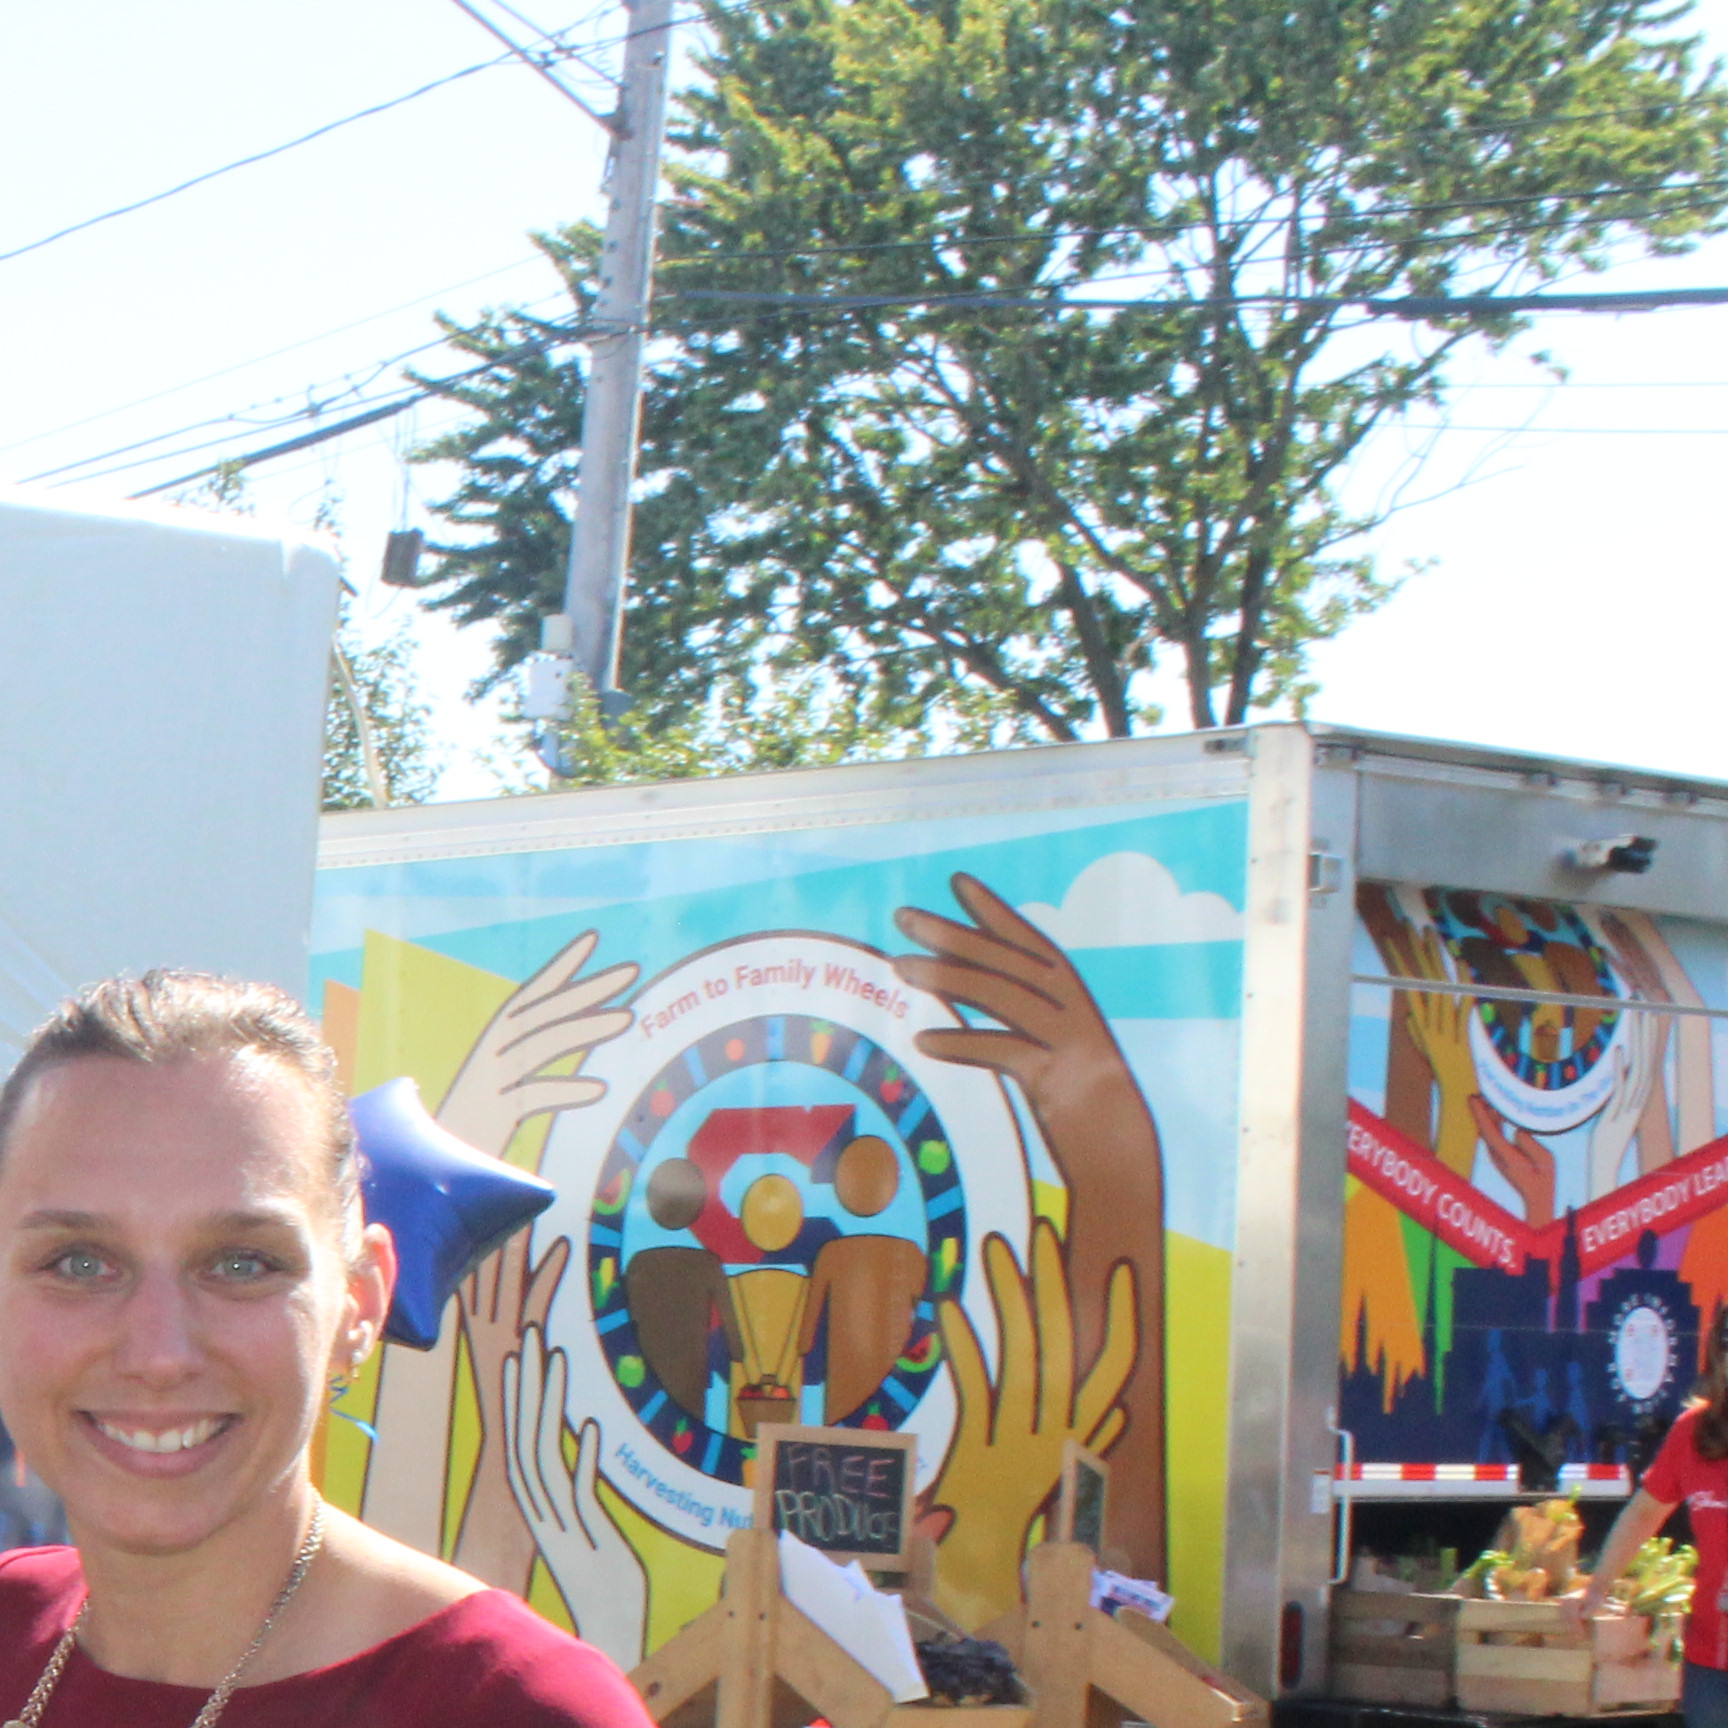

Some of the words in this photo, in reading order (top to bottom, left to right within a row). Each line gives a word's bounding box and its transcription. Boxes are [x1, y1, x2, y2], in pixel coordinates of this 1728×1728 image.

[640, 991, 700, 1038] Farm
[704, 976, 729, 999] to
[733, 957, 817, 991] Family
[823, 961, 910, 1019] Wheels
[1347, 1121, 1438, 1204] ERYBODY
[1581, 1178, 1689, 1253] EVERYBODY
[1693, 1155, 1728, 1195] LEA
[615, 1442, 714, 1527] Harvesting
[786, 1443, 896, 1499] FREE
